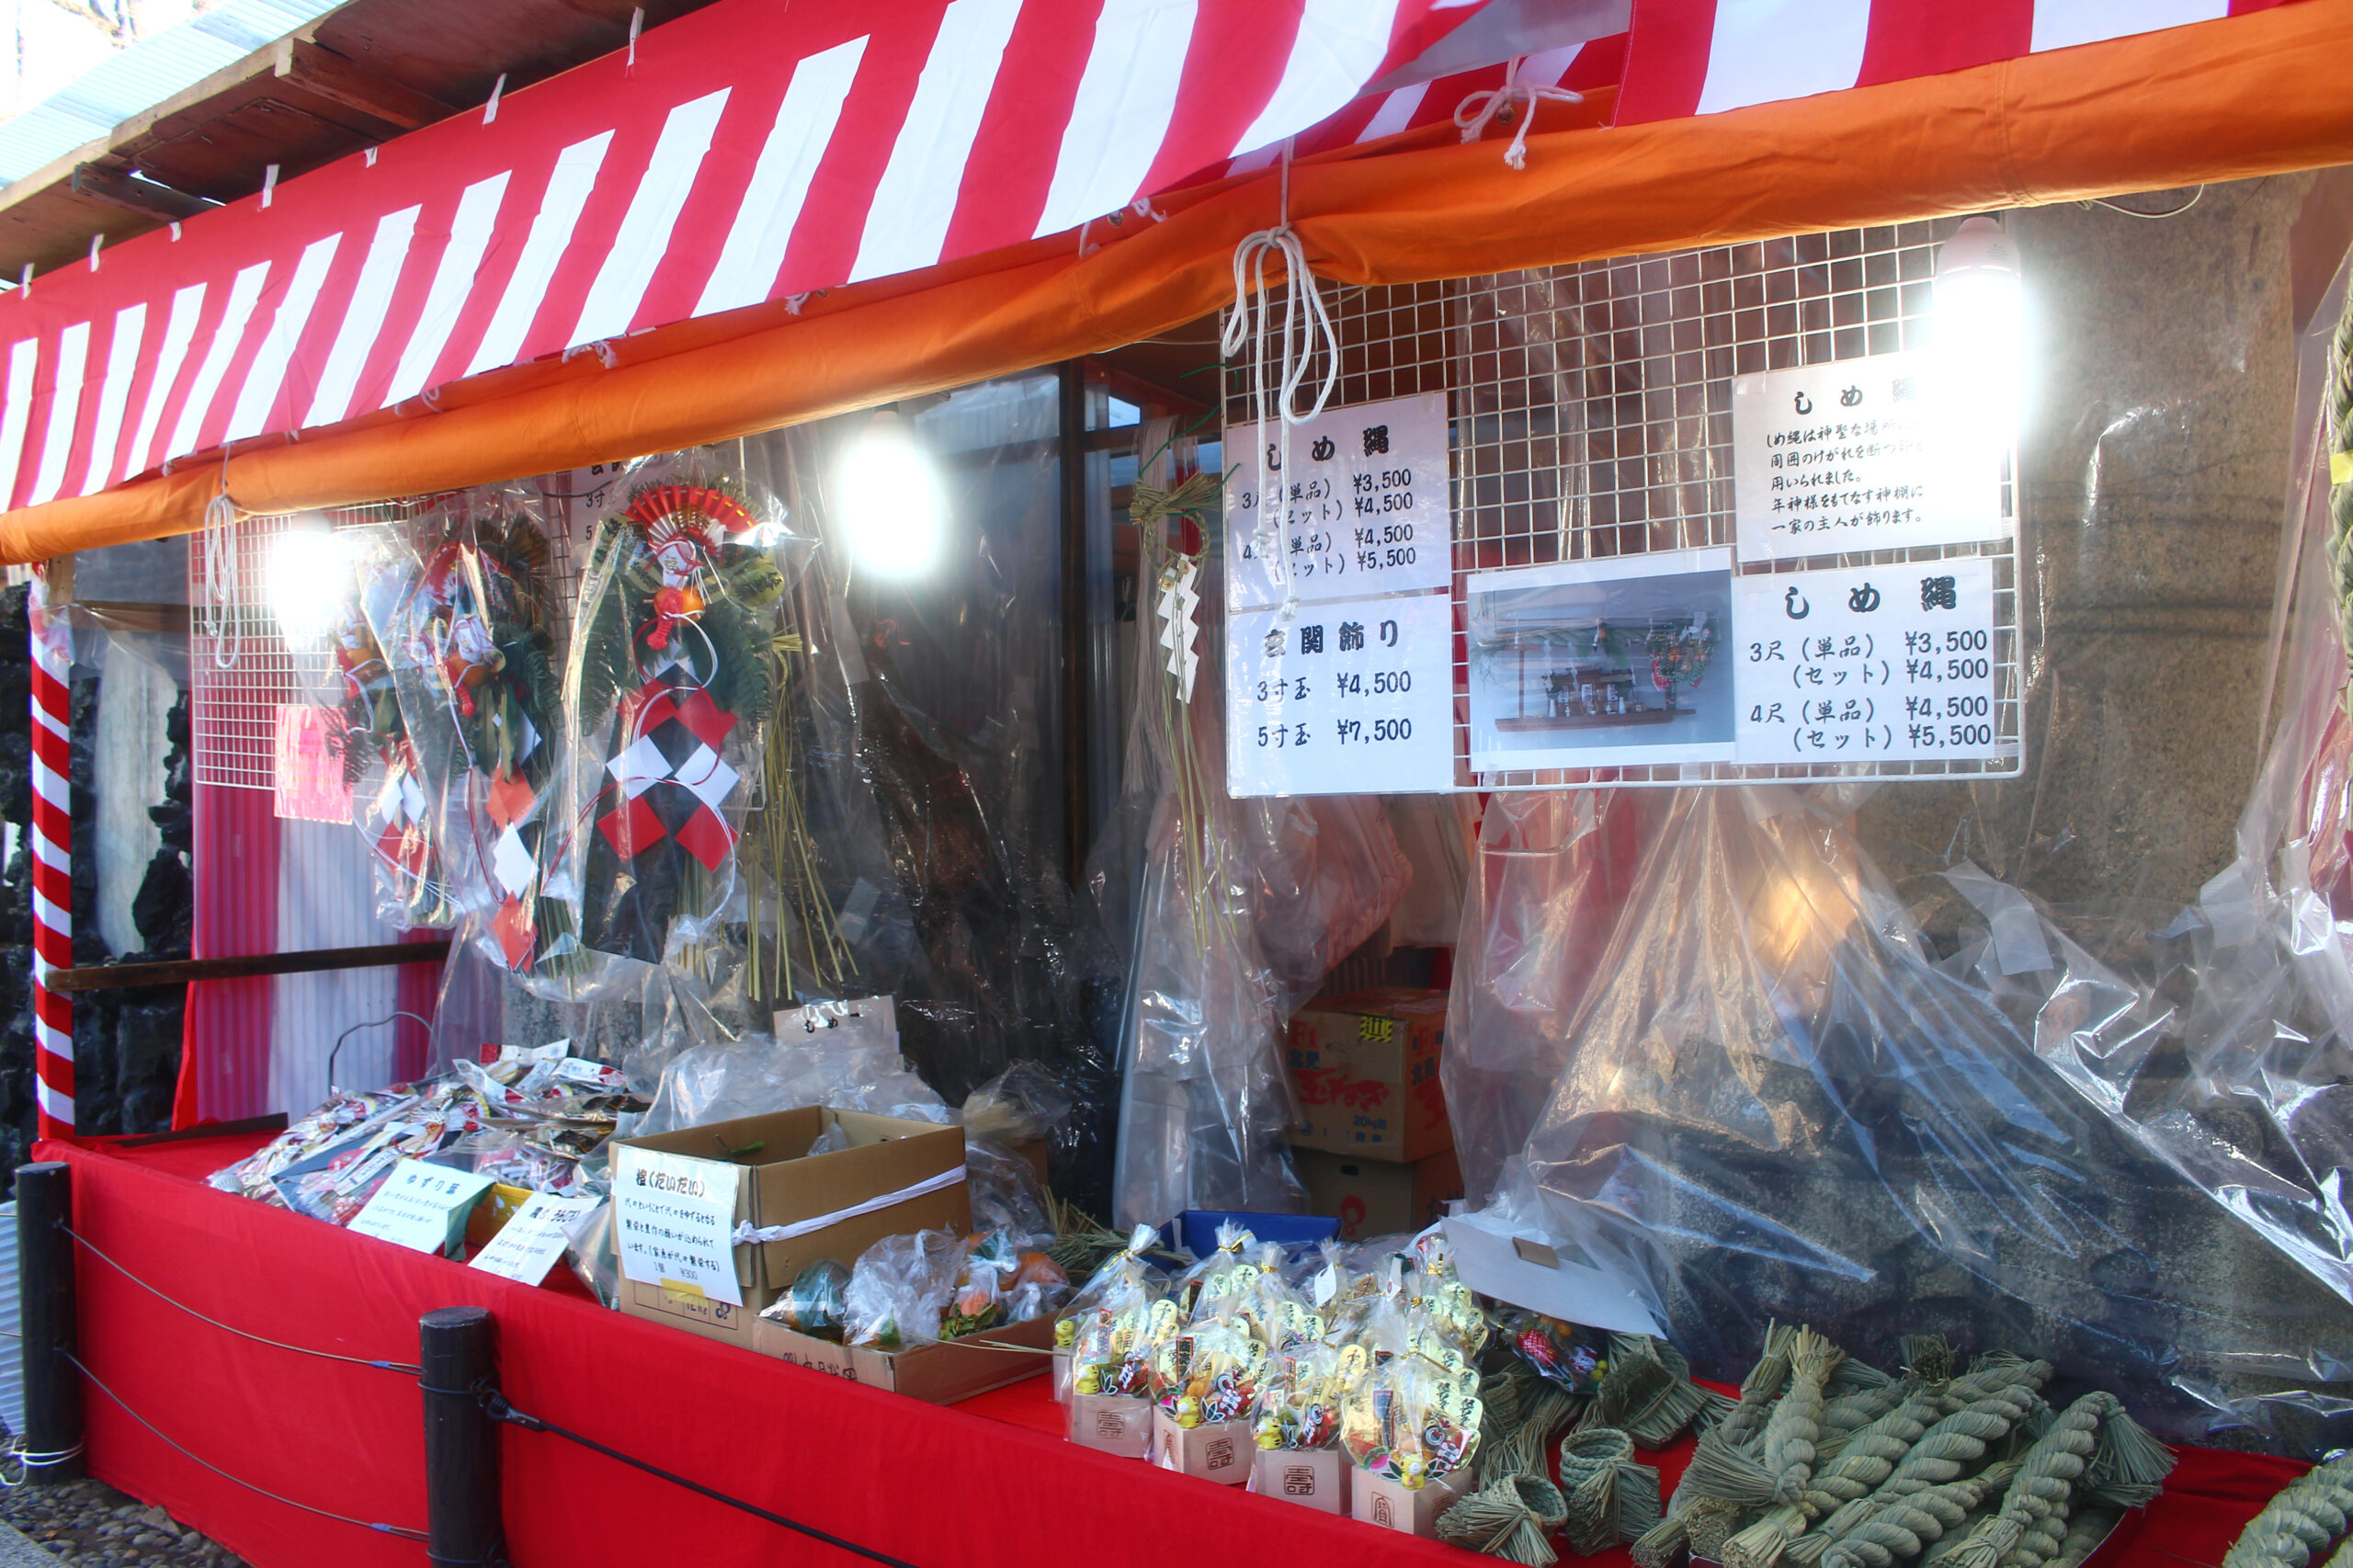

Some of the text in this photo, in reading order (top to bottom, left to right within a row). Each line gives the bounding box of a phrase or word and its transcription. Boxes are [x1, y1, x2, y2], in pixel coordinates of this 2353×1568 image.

[1353, 468, 1412, 495] ¥3,500
[1354, 492, 1413, 518] ¥4,500
[1355, 524, 1414, 550] ¥4,500
[1357, 546, 1416, 573] ¥5,500
[1785, 575, 1957, 620] しめ縄
[1265, 619, 1399, 658] 玄関飾り
[1904, 630, 1988, 656] ¥3,500
[1906, 657, 1989, 684] ¥4,500
[1256, 670, 1412, 703] 3寸玉 ¥4,500
[1905, 695, 1989, 721] ¥4,500
[1257, 718, 1413, 748] 5寸玉 ¥7,500
[1909, 722, 1992, 749] ¥5,500
